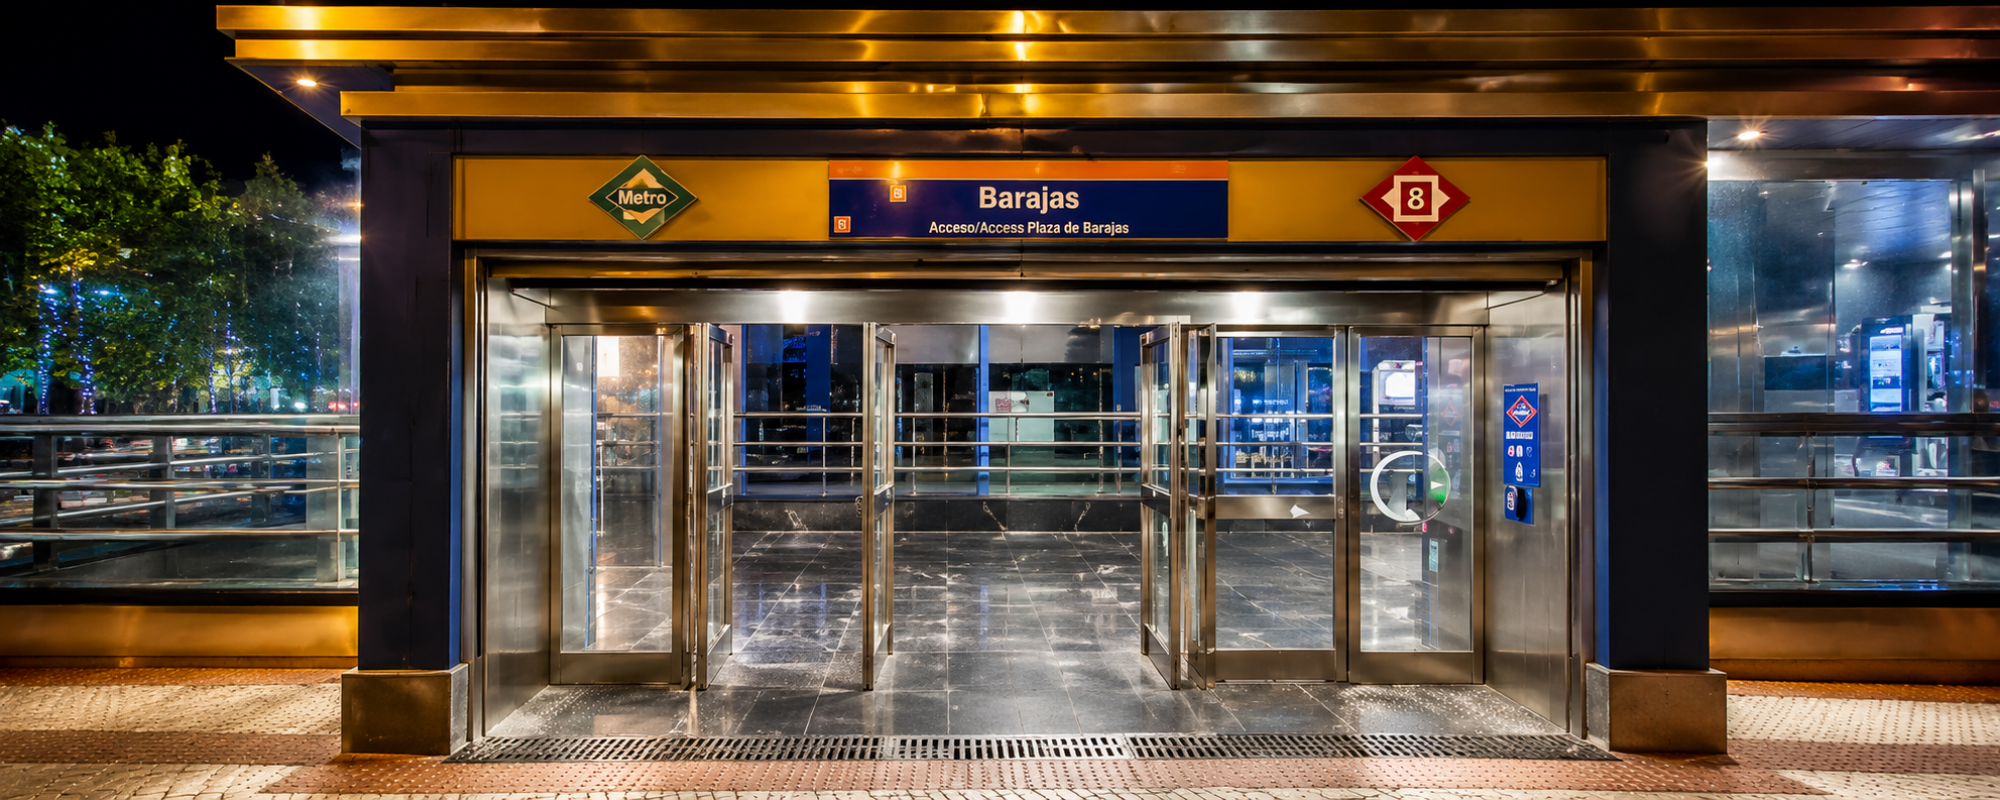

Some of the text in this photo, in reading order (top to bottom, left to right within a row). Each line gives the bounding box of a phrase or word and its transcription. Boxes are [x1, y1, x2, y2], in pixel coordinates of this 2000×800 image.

[618, 190, 666, 204] Metro
[979, 186, 1080, 214] Barajas
[1407, 187, 1424, 210] 8
[929, 221, 1129, 236] Acceso/Access Plaza de Barajas
